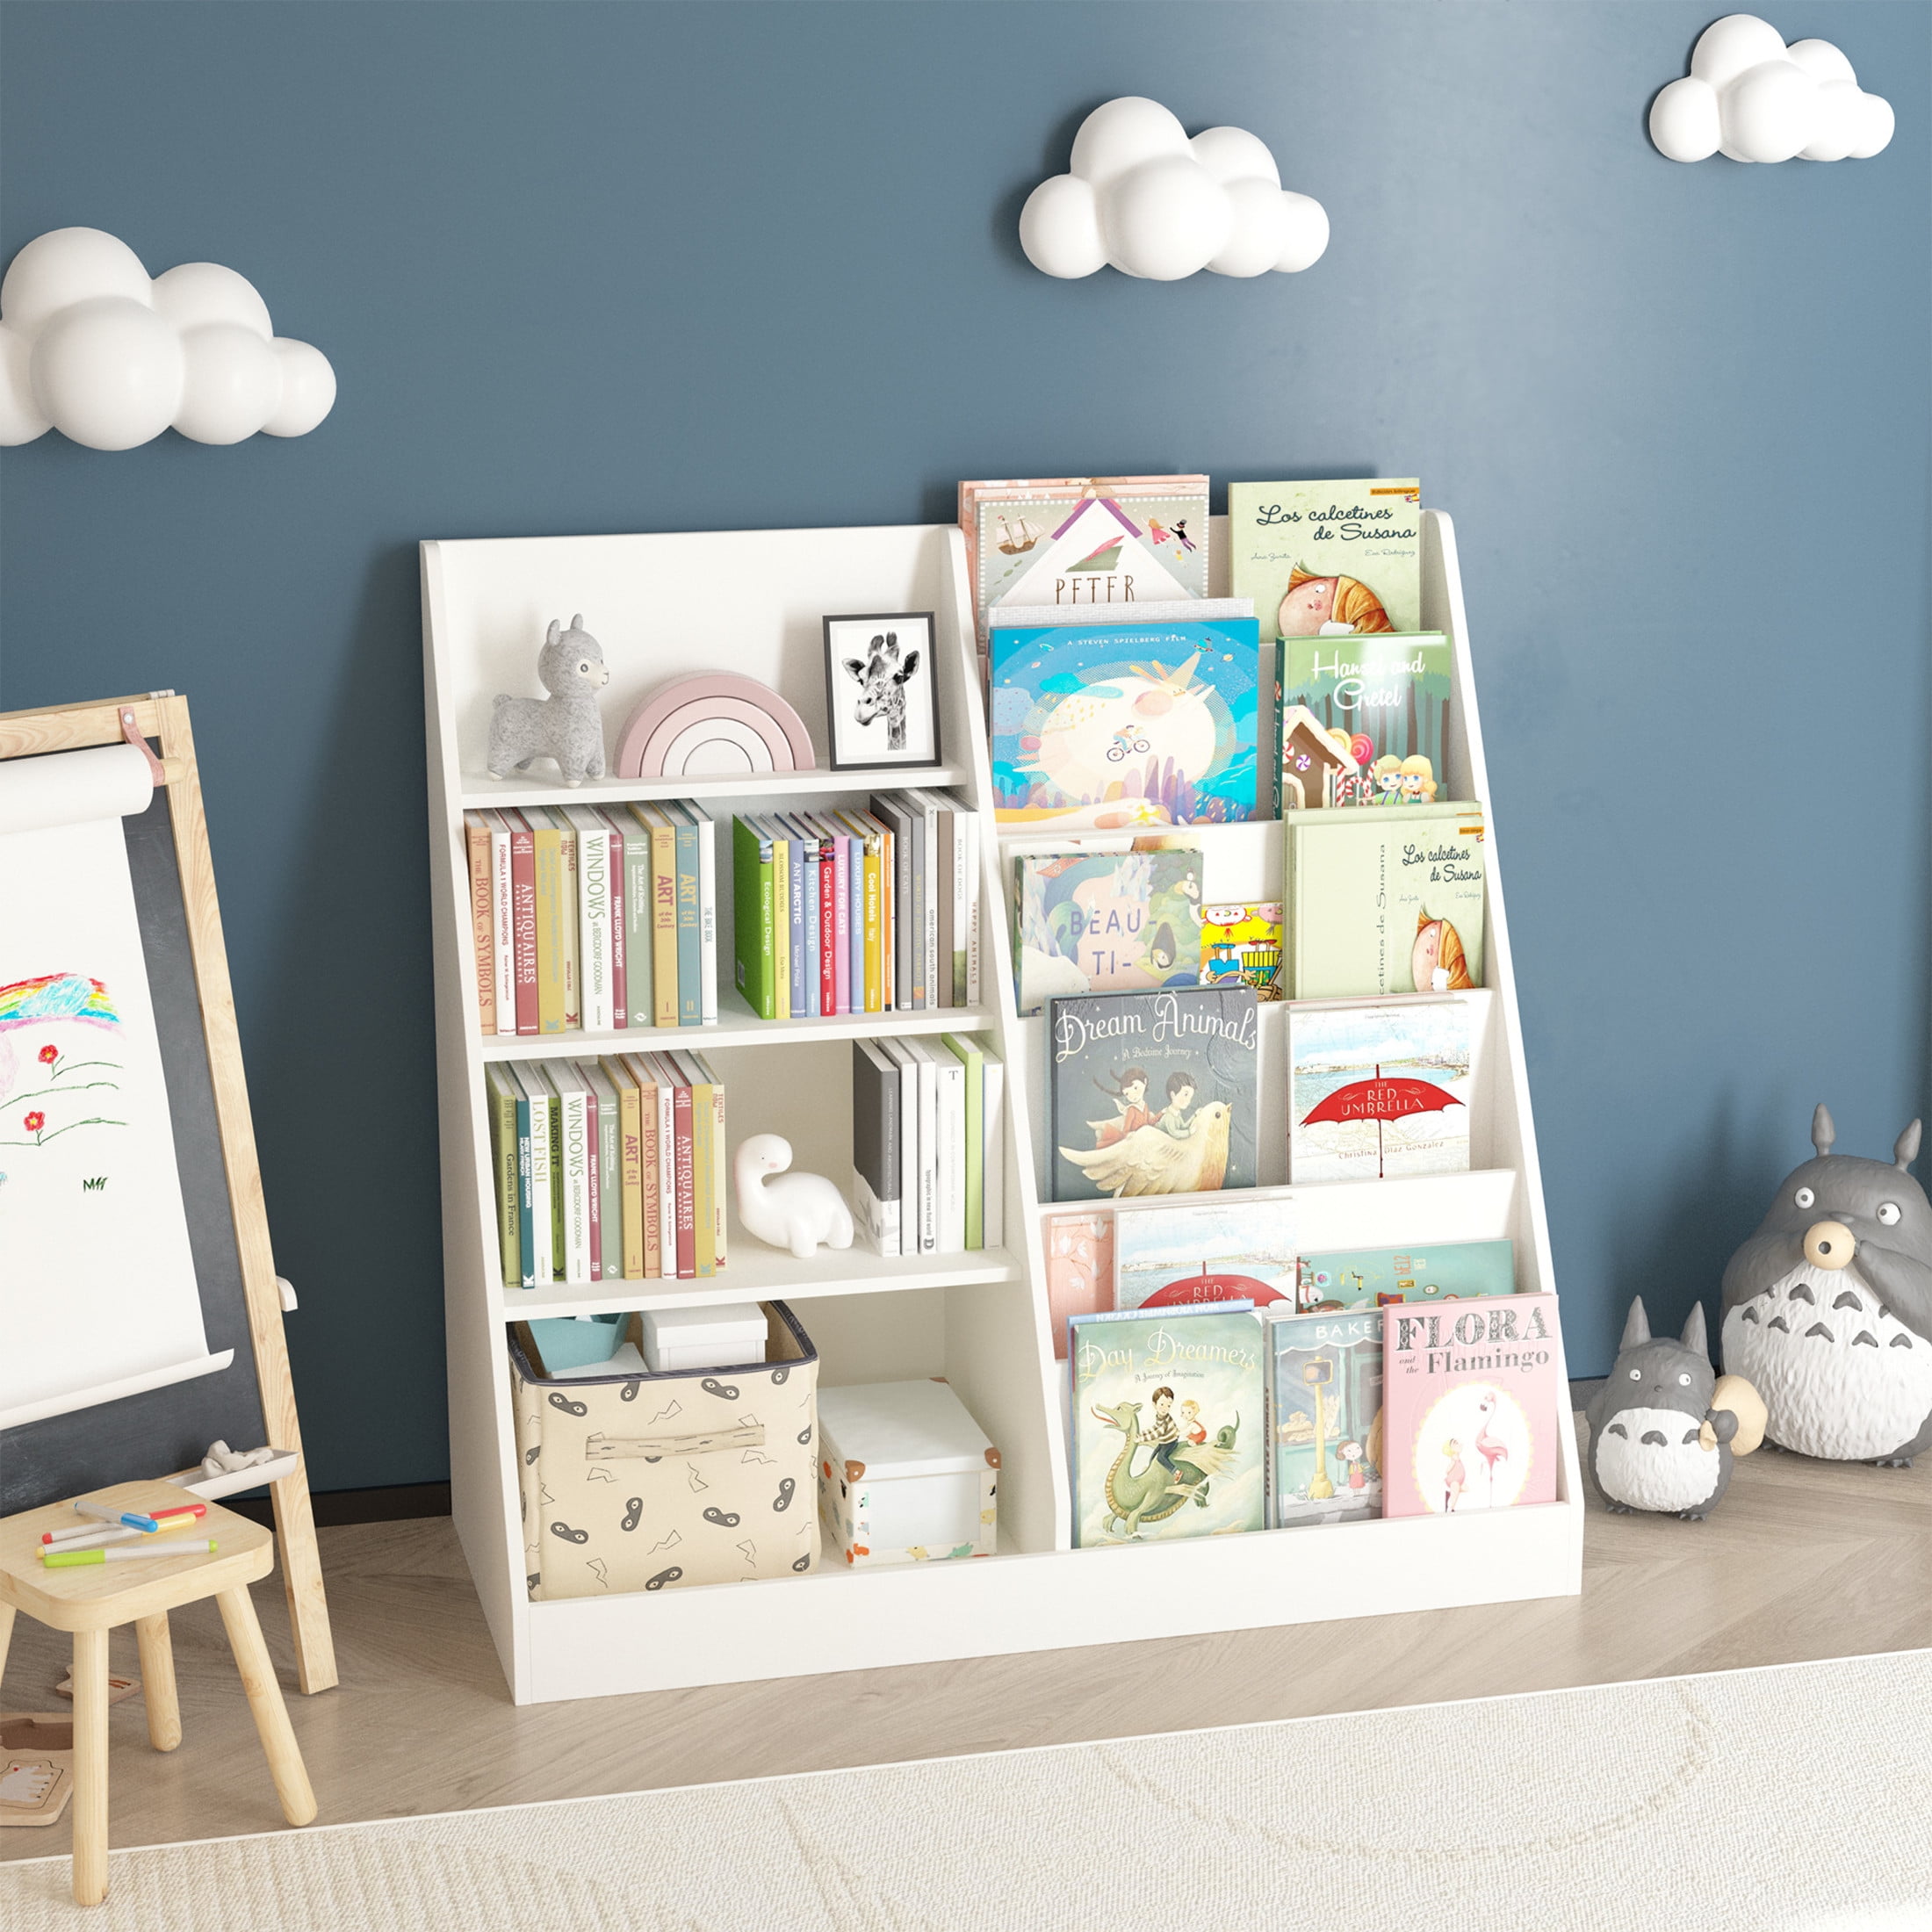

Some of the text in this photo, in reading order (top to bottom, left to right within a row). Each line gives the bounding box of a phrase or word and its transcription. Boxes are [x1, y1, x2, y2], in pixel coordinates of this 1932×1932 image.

[1256, 504, 1394, 526] Los calcetines
[1314, 523, 1417, 541] de Susana
[1056, 574, 1135, 605] PETER
[1390, 651, 1425, 674] and
[1333, 678, 1402, 712] Gretel
[1402, 843, 1470, 867] Los calcetines
[586, 836, 606, 920] WINDOWS
[1376, 844, 1386, 909] Susana
[1431, 863, 1481, 883] de Susana
[475, 877, 490, 919] BOOK
[657, 875, 674, 905] ART
[680, 874, 696, 905] ART
[793, 861, 802, 925] ANTARCTIC
[868, 894, 876, 922] Hotels
[1071, 908, 1157, 935] BEAU-
[520, 883, 536, 984] ANTIQUAIRES
[808, 916, 817, 952] Design
[824, 912, 833, 948] Outdoor
[1376, 915, 1385, 934] de
[477, 934, 492, 1007] SYMBOLS
[823, 950, 833, 980] Design
[1092, 950, 1132, 976] TI-
[1055, 993, 1257, 1063] Dream Animals
[1121, 1044, 1193, 1061] A Bedtime Journey
[948, 1071, 958, 1080] T
[1341, 1098, 1424, 1115] UMBRELLA
[1366, 1088, 1397, 1101] RED
[533, 1101, 547, 1183] LOST FISH
[550, 1107, 559, 1152] MAKING
[568, 1098, 584, 1178] WINDOWS
[551, 1155, 559, 1167] IT
[625, 1134, 638, 1164] ART
[645, 1129, 656, 1168] BOOK
[1338, 1150, 1378, 1159] Christina
[506, 1154, 516, 1236] Gardens in France
[680, 1135, 694, 1229] ANTIQUAIRES
[646, 1183, 658, 1251] SYMBOLS
[923, 1237, 934, 1250] D
[1193, 1286, 1223, 1298] RED
[1395, 1306, 1554, 1352] FLORA
[1078, 1325, 1257, 1383] Day Dreamers
[1399, 1348, 1550, 1374] and Flamingo
[1172, 1369, 1205, 1379] Imagination
[1406, 1365, 1419, 1374] the
